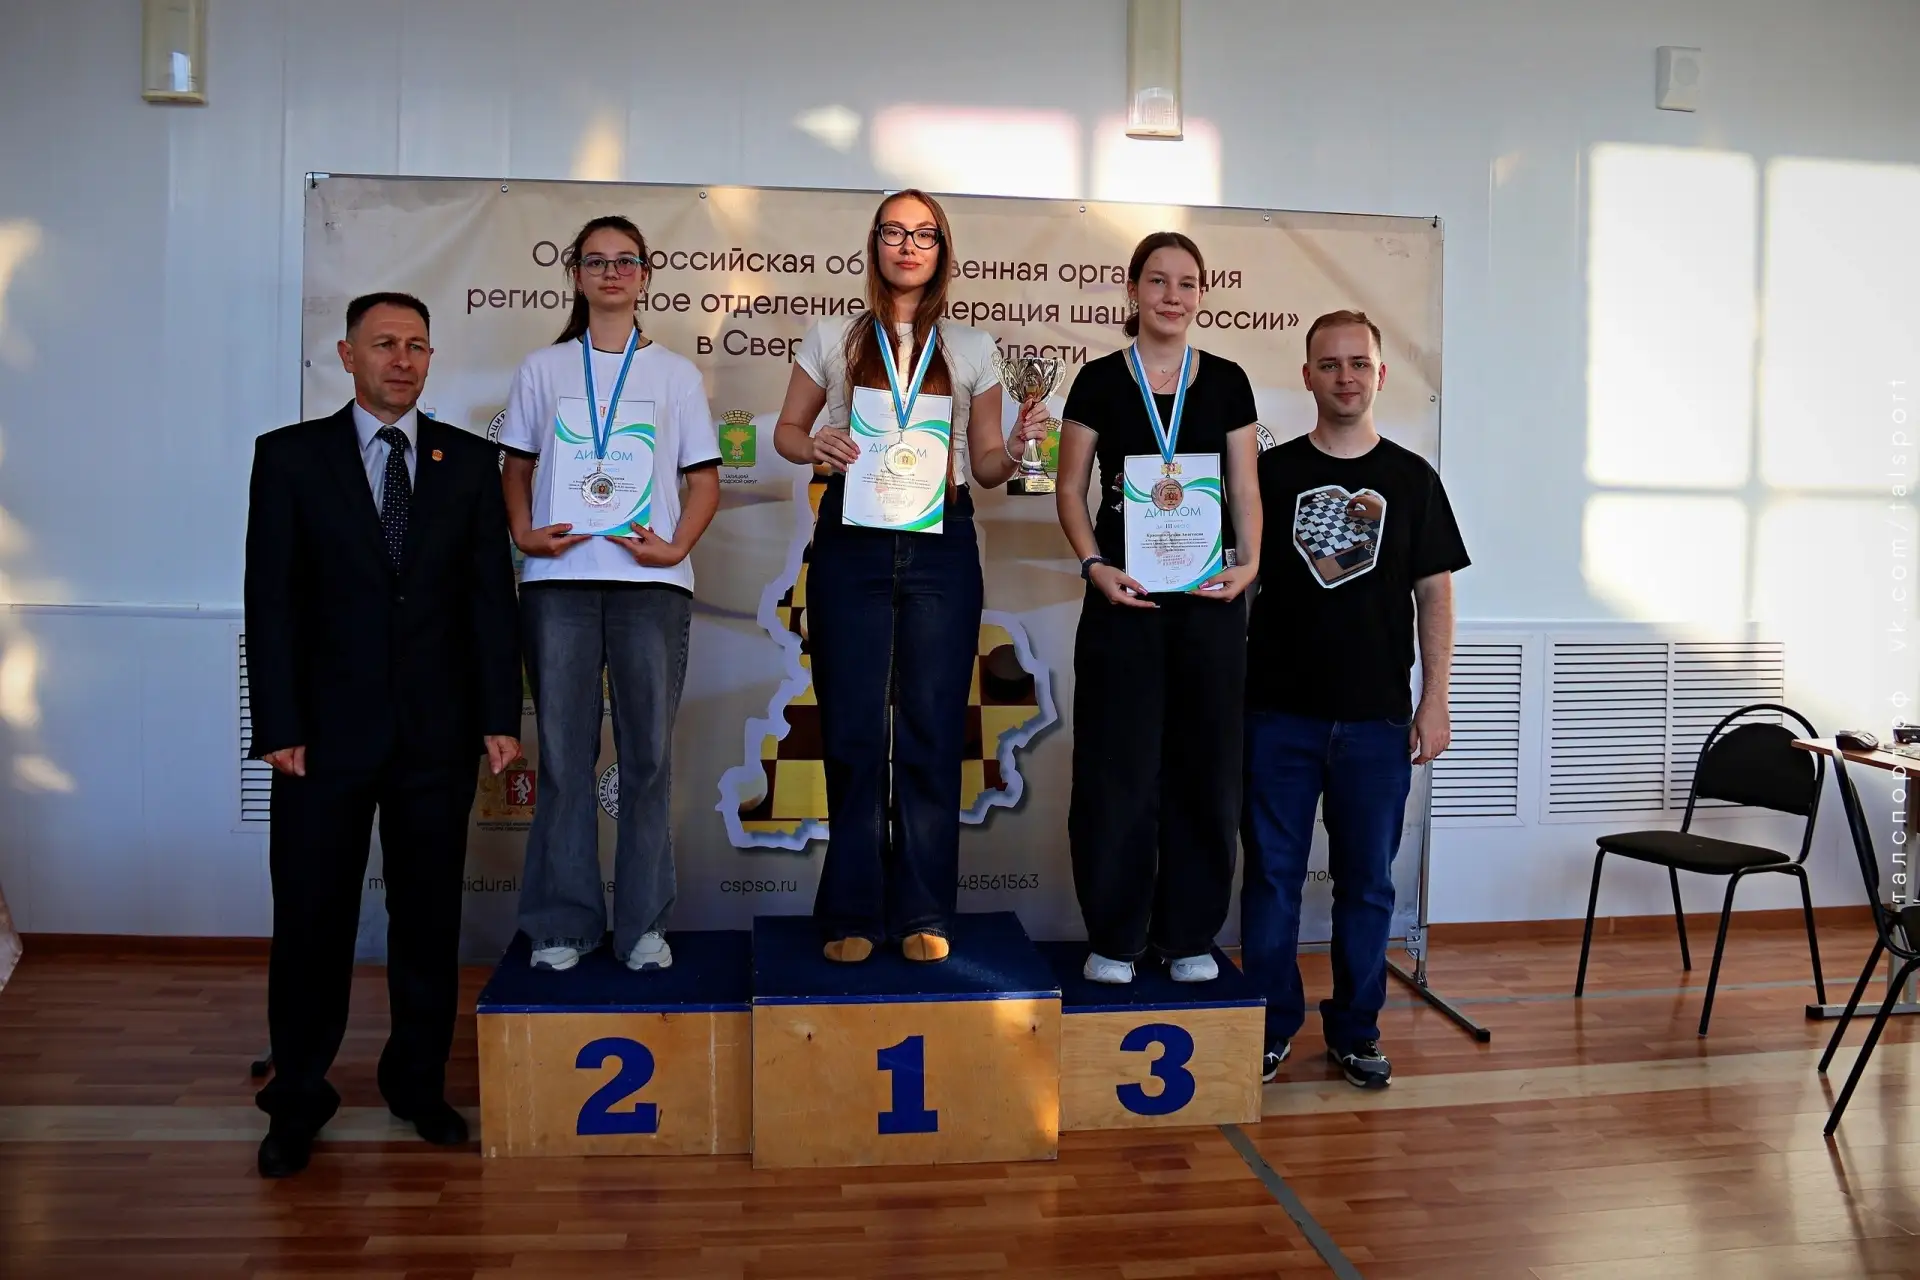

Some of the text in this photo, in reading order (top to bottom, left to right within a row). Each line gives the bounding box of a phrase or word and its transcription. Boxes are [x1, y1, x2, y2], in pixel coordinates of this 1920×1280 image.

[701, 293, 866, 318] отделение
[1196, 309, 1299, 331] оссии»
[697, 336, 712, 354] в
[1144, 506, 1201, 519] ДИПЛОМ
[720, 879, 797, 895] cspso.ru
[574, 1036, 658, 1135] 2
[876, 1035, 938, 1134] 1
[1115, 1023, 1196, 1116] 3
